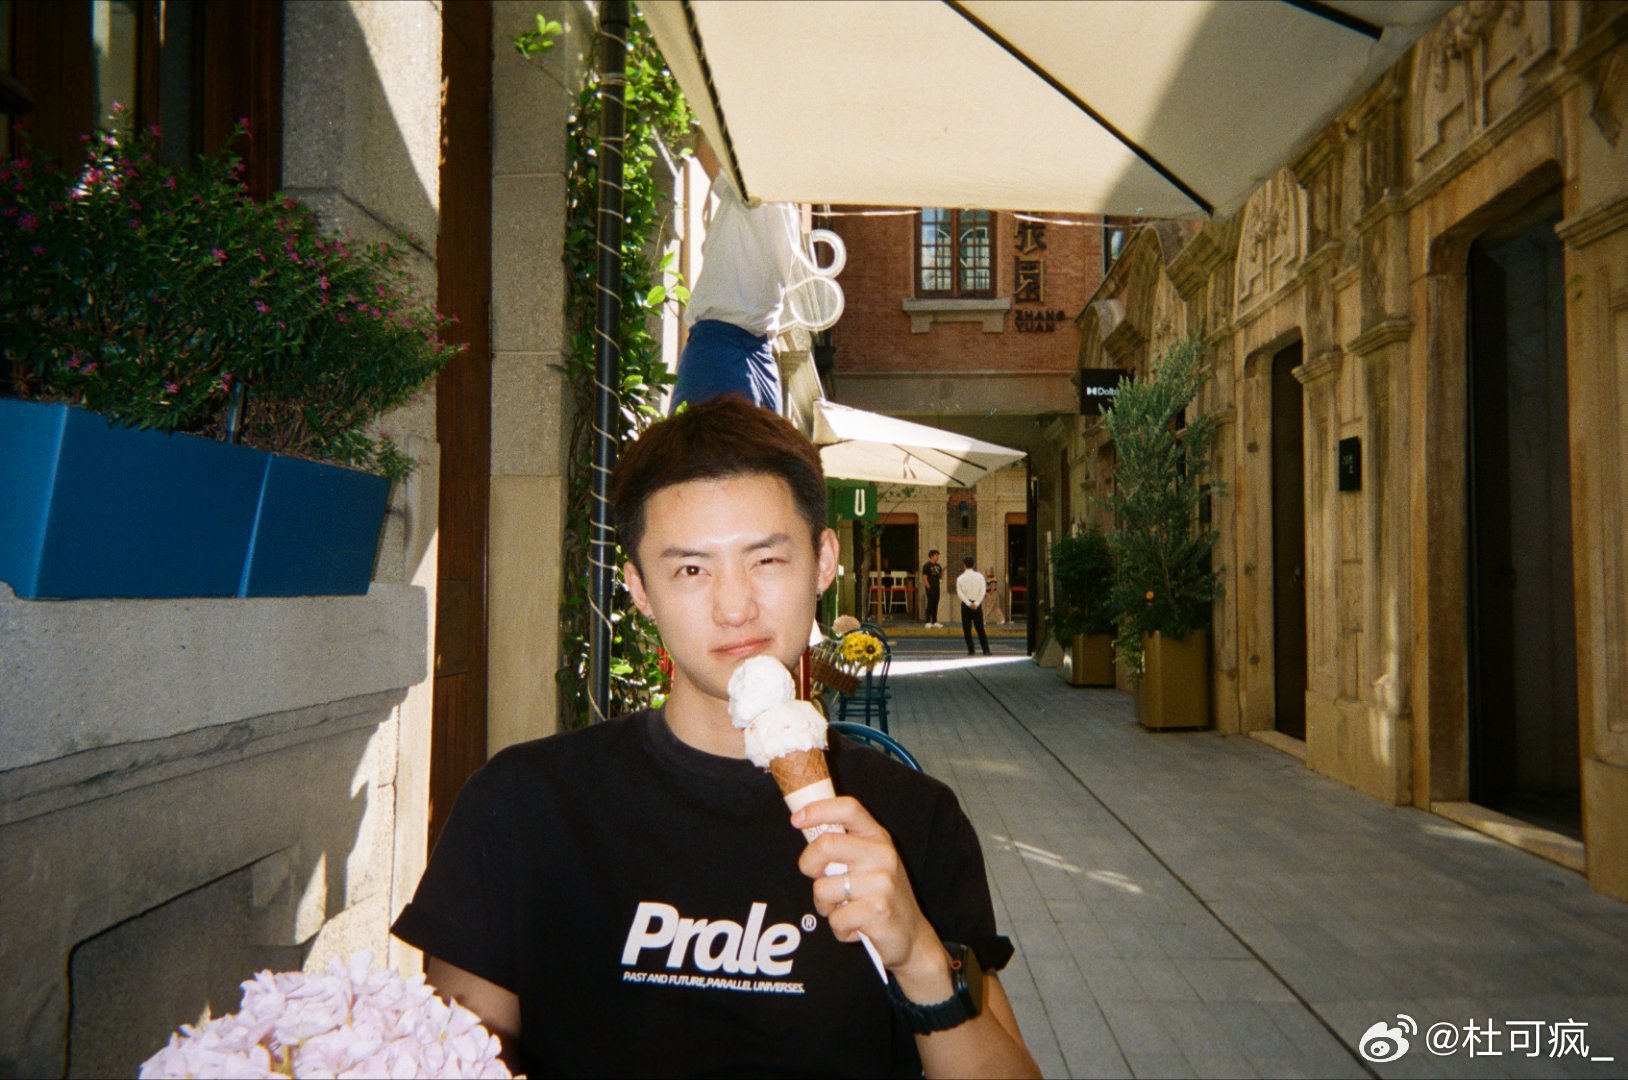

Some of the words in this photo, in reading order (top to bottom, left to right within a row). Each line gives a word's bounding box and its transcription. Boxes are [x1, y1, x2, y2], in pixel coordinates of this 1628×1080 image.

[1015, 321, 1056, 333] YUAN
[1097, 387, 1118, 396] Dolb
[623, 971, 648, 982] PAST
[647, 973, 668, 984] AND
[752, 980, 805, 993] UNIVERSES.
